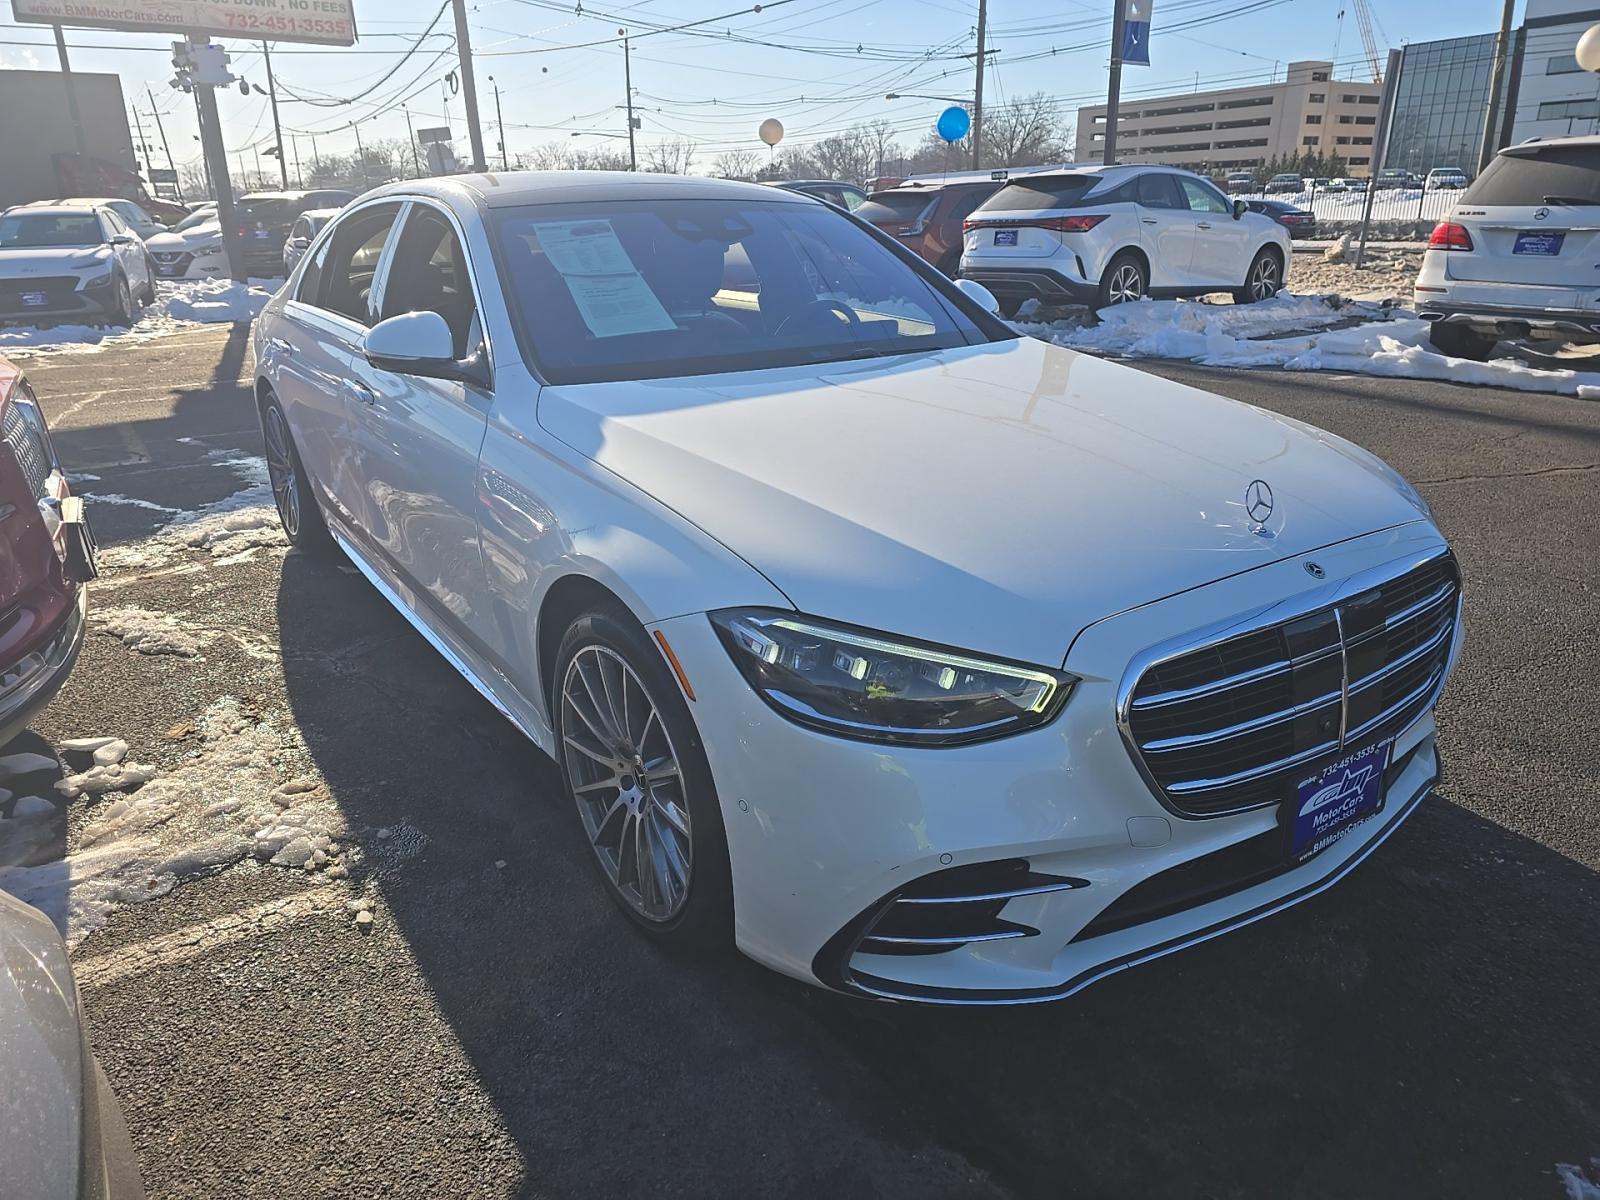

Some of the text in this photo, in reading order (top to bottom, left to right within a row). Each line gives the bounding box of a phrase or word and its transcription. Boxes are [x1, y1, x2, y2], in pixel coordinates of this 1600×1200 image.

[289, 0, 308, 10] NO
[313, 2, 347, 13] FEES
[225, 13, 346, 33] 732-451-3535
[1312, 794, 1364, 828] MotorCars
